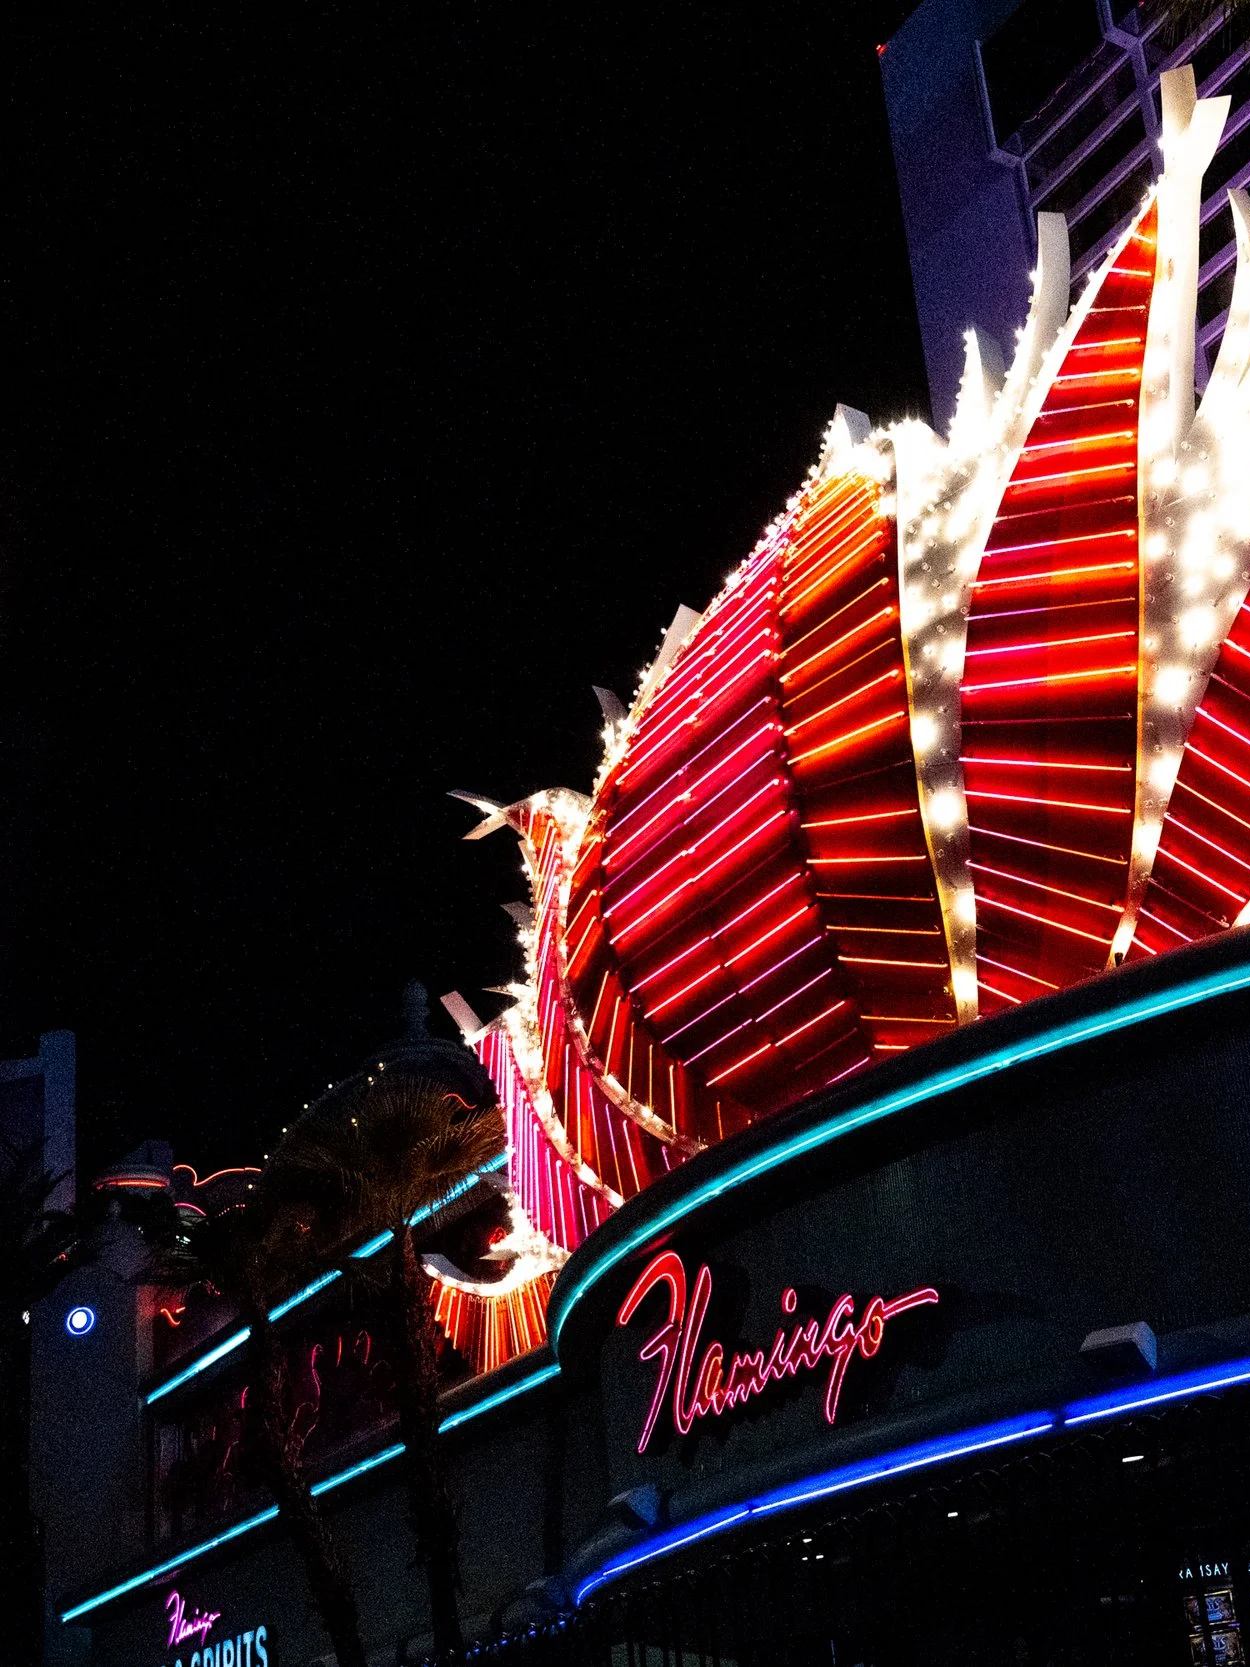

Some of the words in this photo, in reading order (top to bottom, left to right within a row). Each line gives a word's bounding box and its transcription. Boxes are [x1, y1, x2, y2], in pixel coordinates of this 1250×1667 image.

[617, 1250, 939, 1453] Flamingo
[1179, 1562, 1229, 1579] ASAY
[190, 1625, 268, 1667] IRITS
